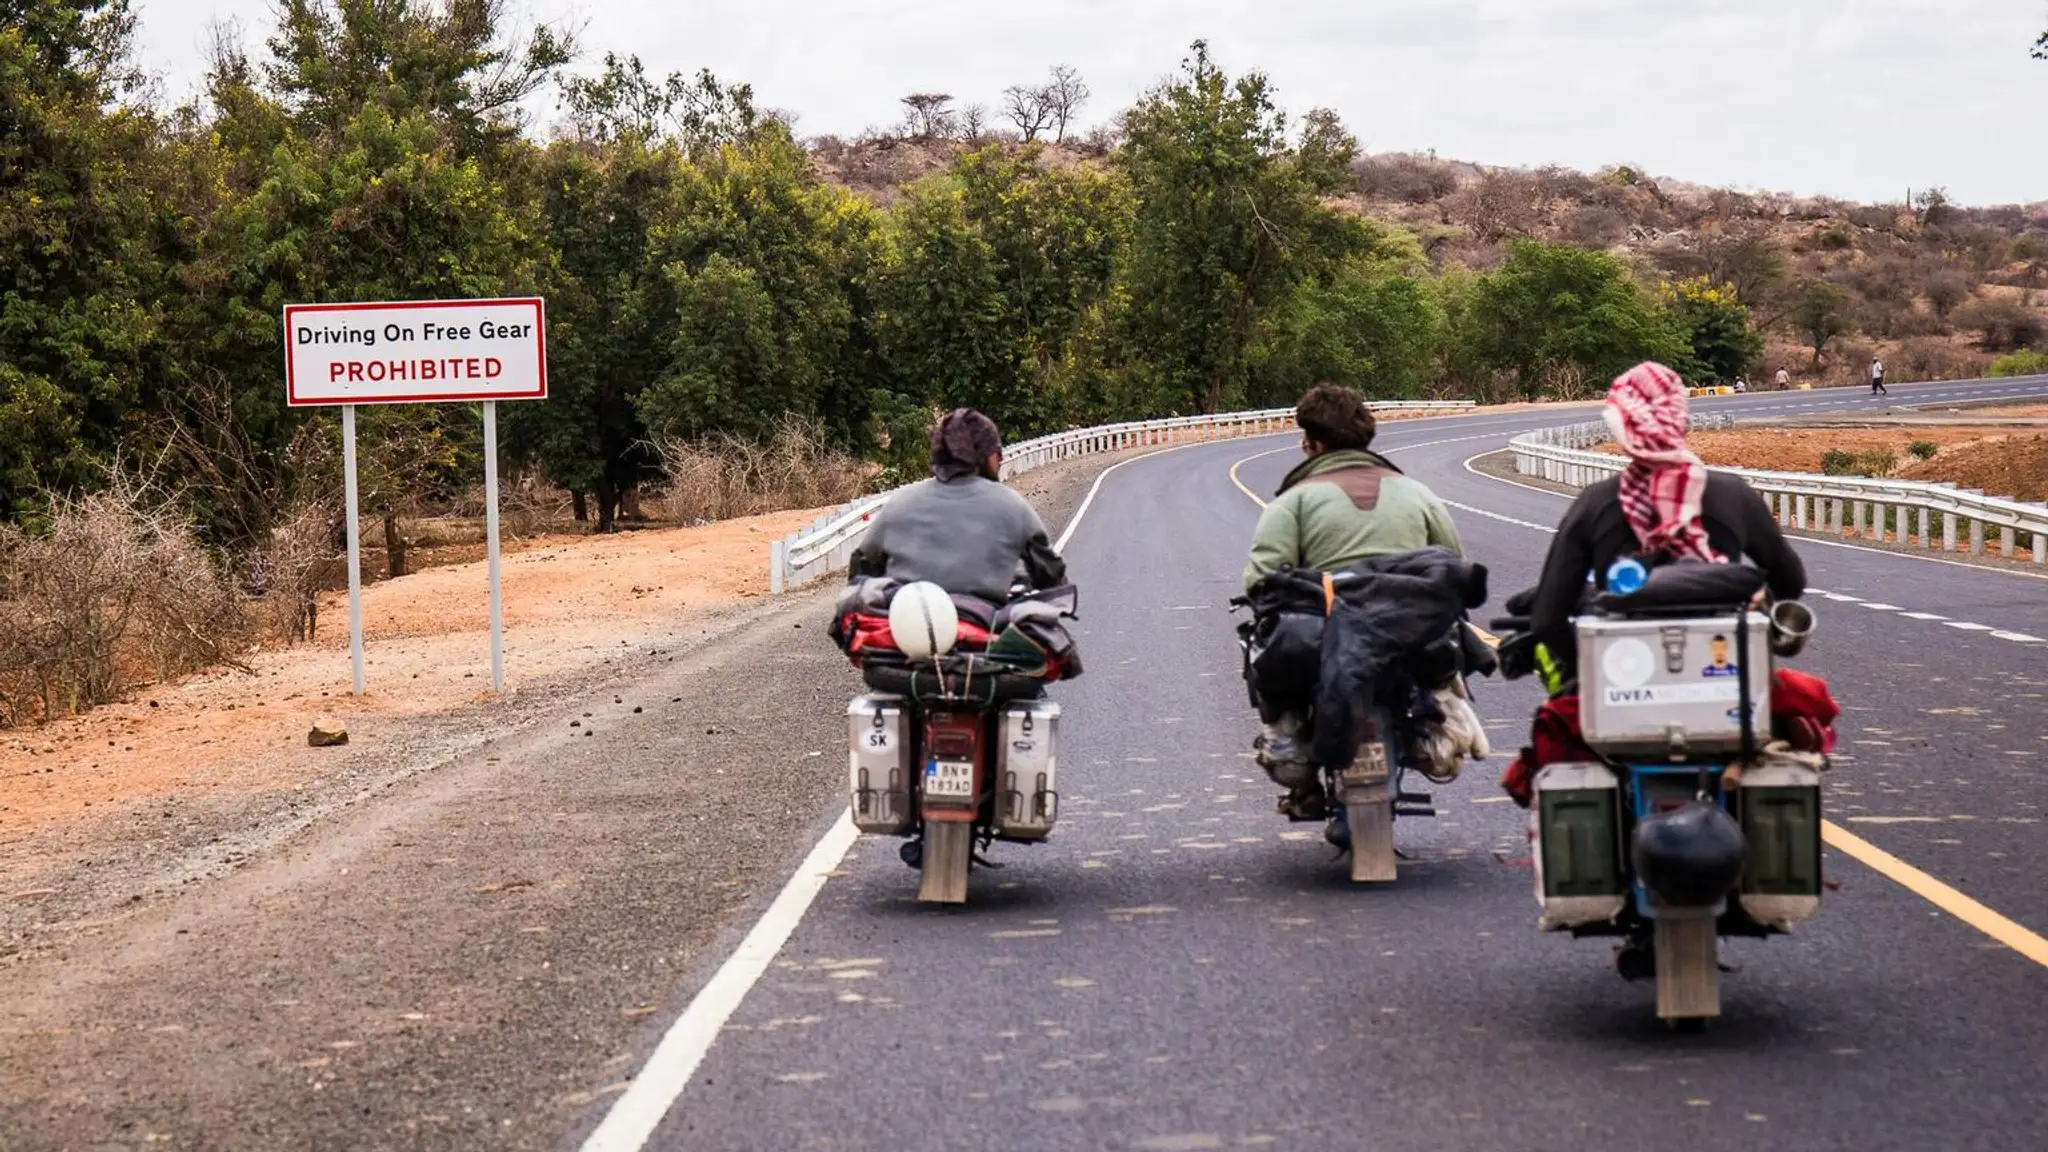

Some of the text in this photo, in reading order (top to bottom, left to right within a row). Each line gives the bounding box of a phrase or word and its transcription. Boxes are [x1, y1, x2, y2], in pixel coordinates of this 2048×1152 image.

[297, 321, 531, 346] Driving On Free Gear
[330, 358, 502, 382] PROHIBITED
[1609, 689, 1654, 702] UVEA
[870, 734, 887, 747] SK
